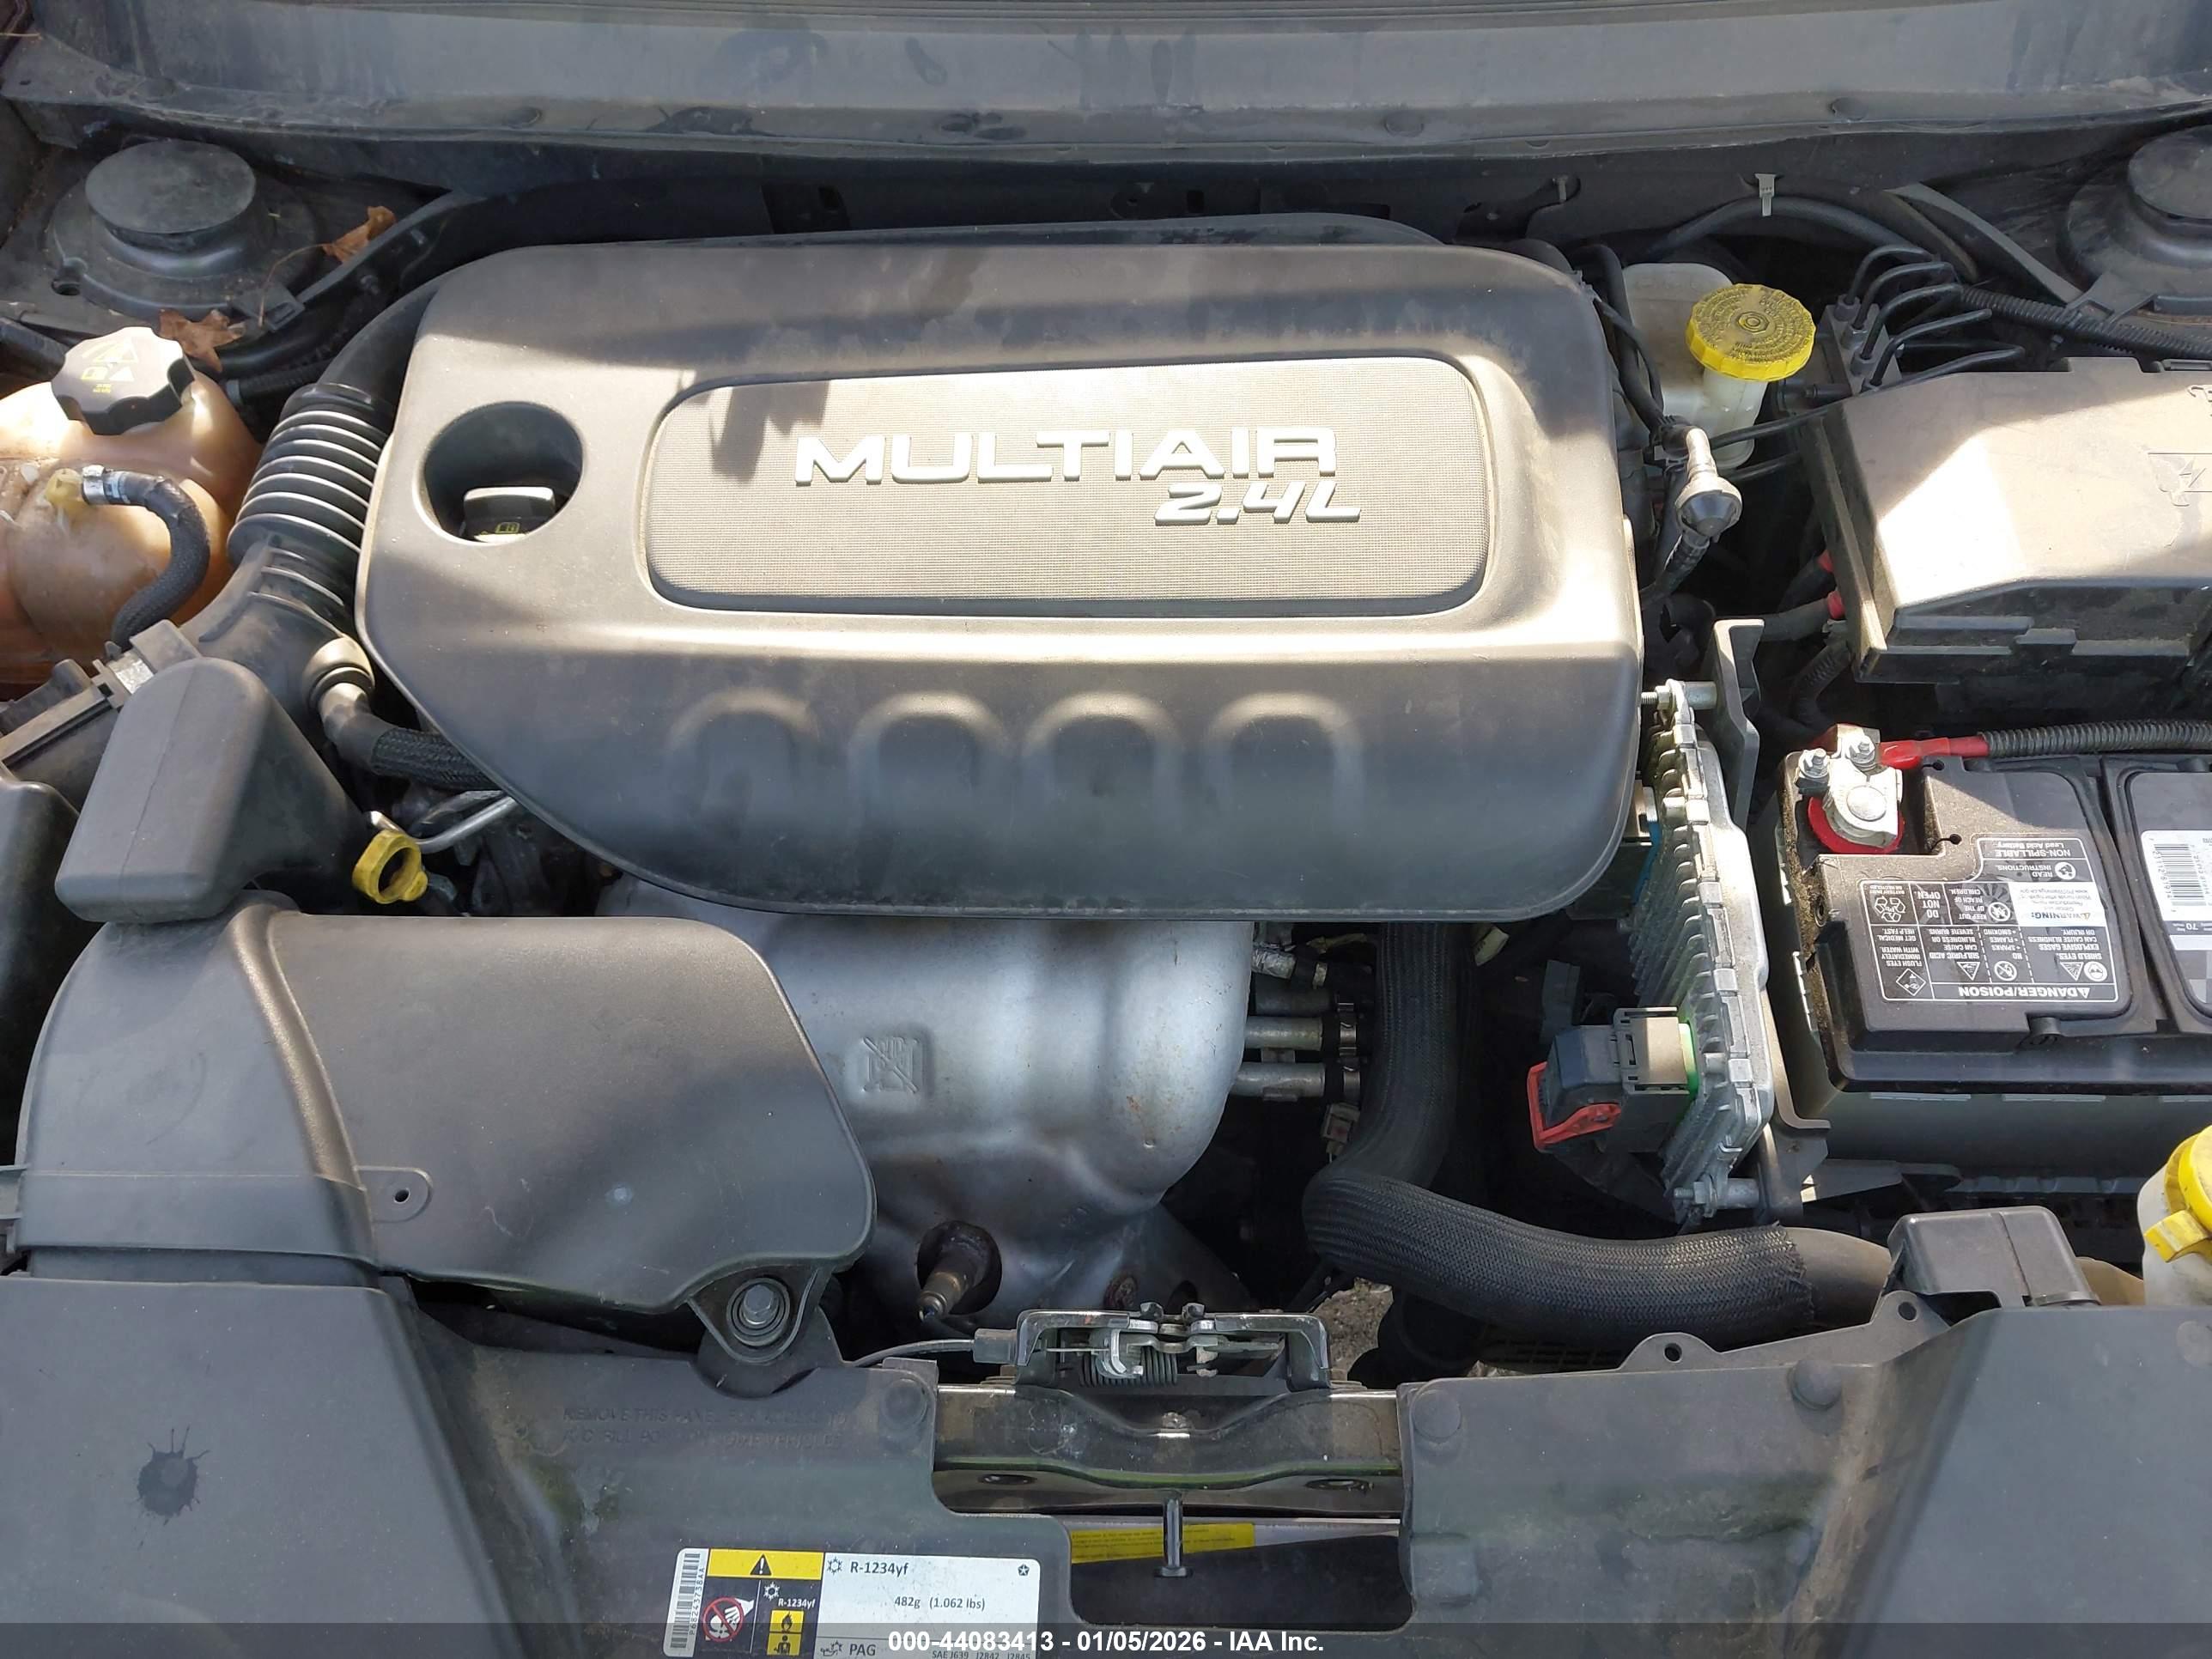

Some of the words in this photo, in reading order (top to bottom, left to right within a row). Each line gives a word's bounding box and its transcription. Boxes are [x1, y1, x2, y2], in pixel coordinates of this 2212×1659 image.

[793, 426, 1339, 486] MULTIAIR
[1154, 482, 1362, 526] 2.4L
[1922, 900, 1940, 908] NOT
[1926, 909, 1939, 918] DO
[2185, 922, 2199, 931] 70
[1958, 986, 2078, 997] DANGER/POISON
[849, 1561, 909, 1577] R-1234yf
[777, 1597, 816, 1609] R-1234yf
[894, 1595, 921, 1610] 482g
[928, 1595, 963, 1610] (1.062
[965, 1596, 986, 1612] lbs)
[849, 1644, 877, 1657] PAG
